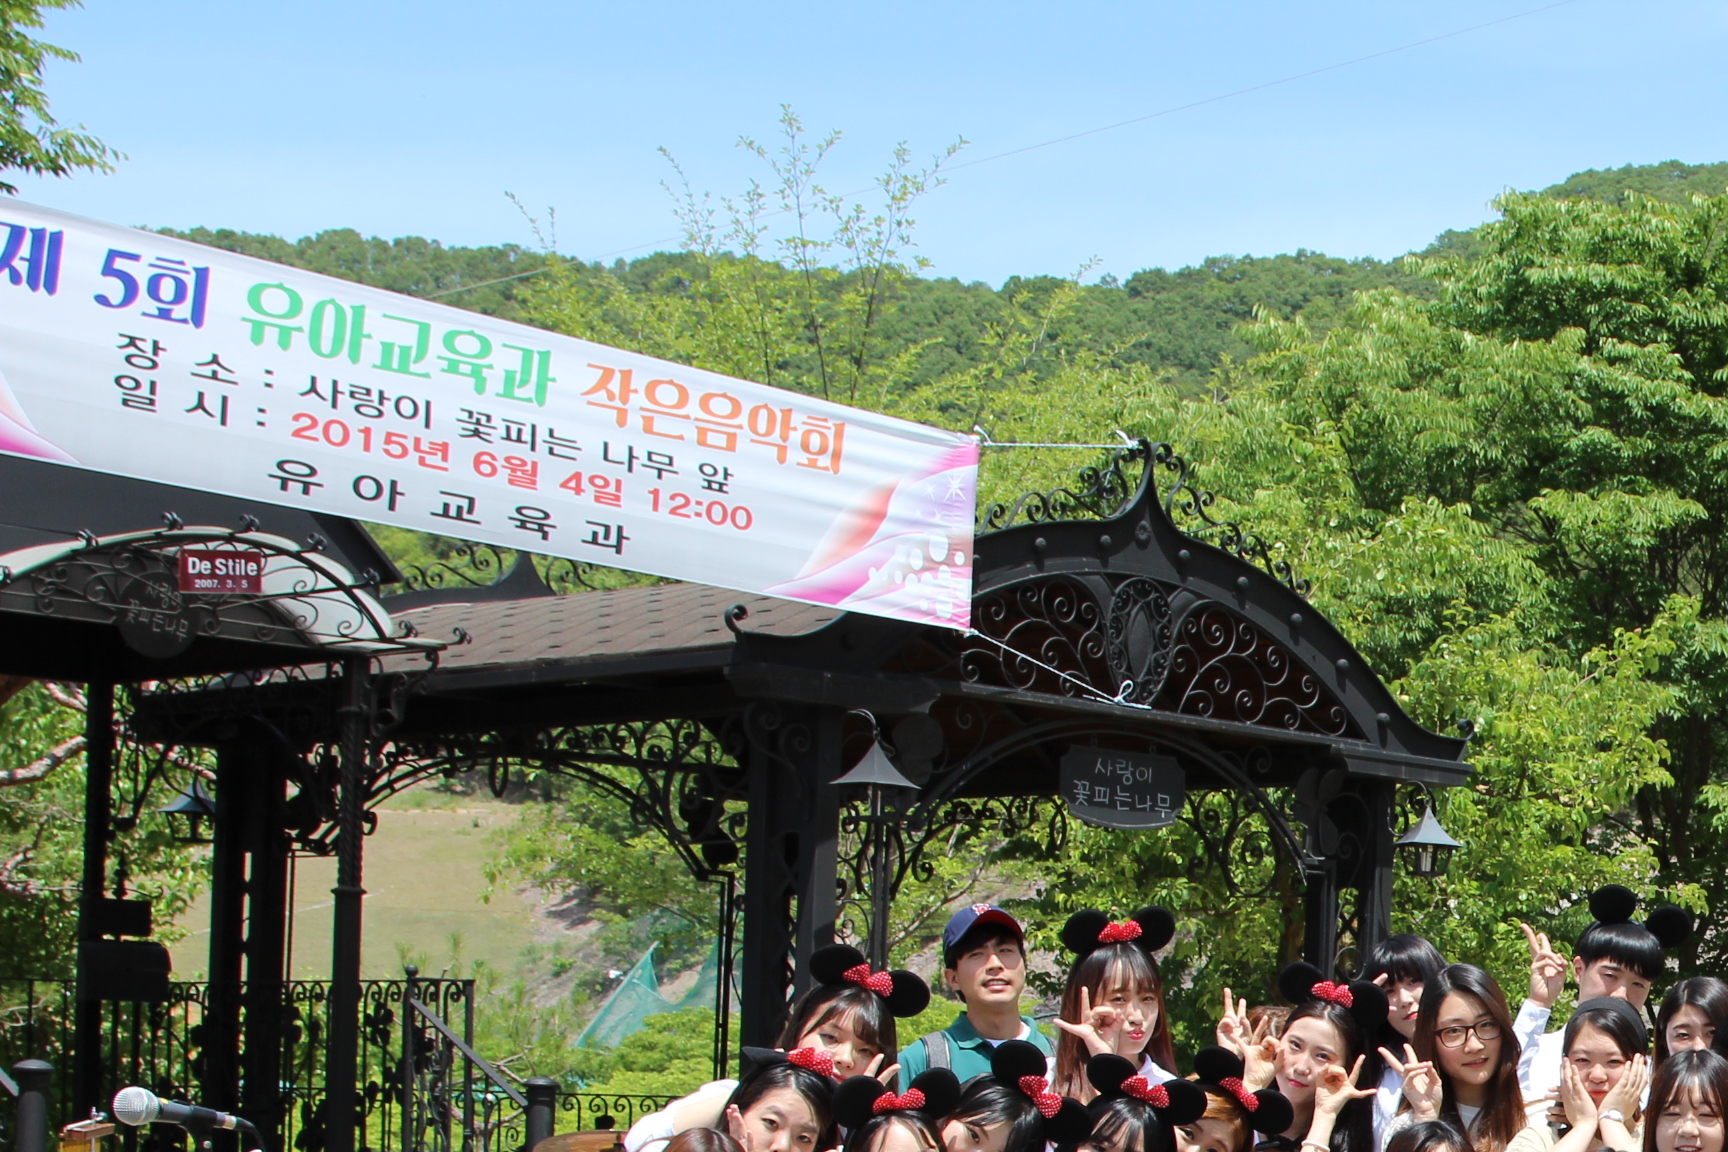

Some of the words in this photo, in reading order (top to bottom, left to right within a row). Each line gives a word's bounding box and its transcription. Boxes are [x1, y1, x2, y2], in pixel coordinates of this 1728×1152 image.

[0, 221, 64, 296] 제
[94, 248, 210, 329] 5회
[241, 282, 556, 407] 유아교육과
[581, 363, 845, 475] 작은음악회
[291, 412, 450, 472] 2015년
[472, 451, 539, 491] 6월
[559, 471, 623, 508] 4일
[647, 488, 754, 531] 12:00
[298, 375, 431, 429] 사랑이
[456, 407, 583, 461] 꽃피는
[602, 441, 679, 479] 나무
[698, 463, 734, 494] 앞
[188, 557, 211, 575] De
[215, 558, 258, 576] Stile
[1073, 780, 1172, 818] 꽃피는나무
[1095, 758, 1152, 785] 사랑이
